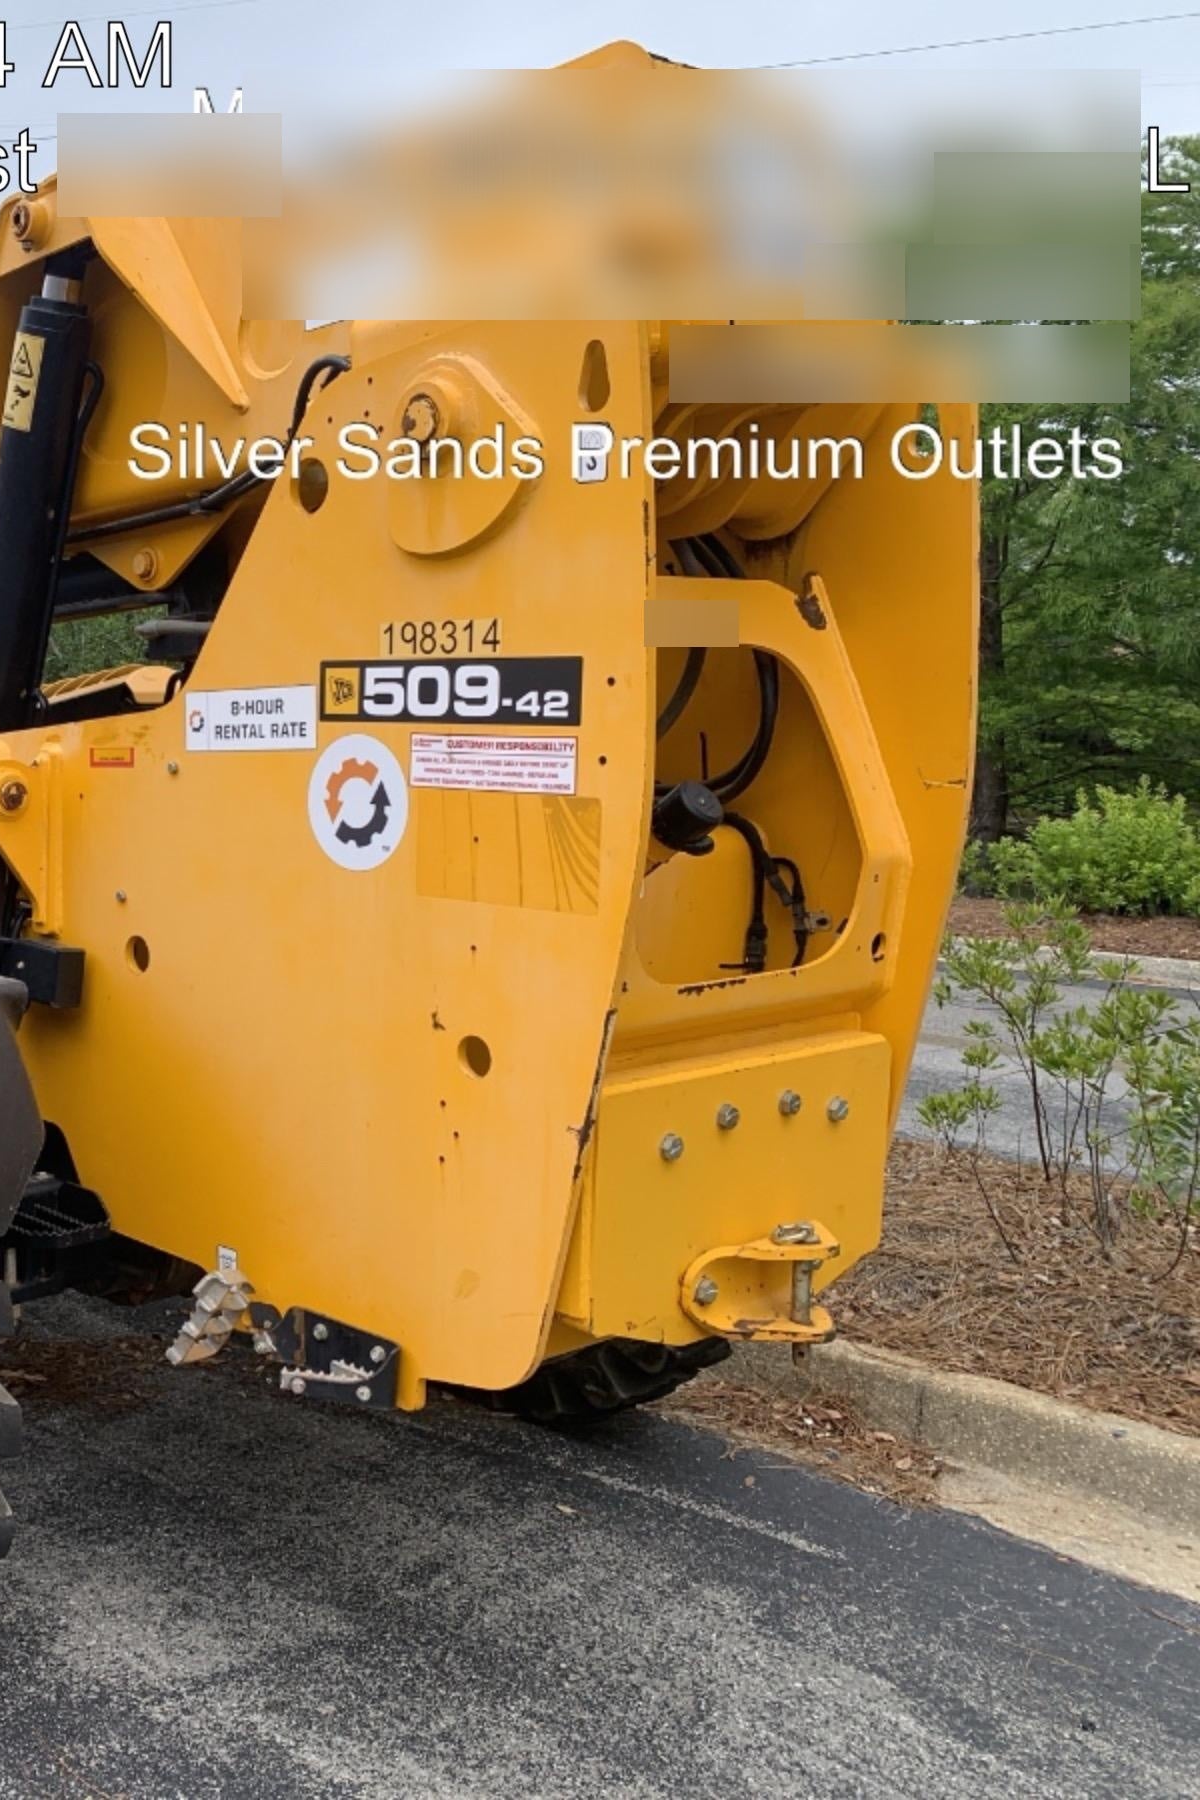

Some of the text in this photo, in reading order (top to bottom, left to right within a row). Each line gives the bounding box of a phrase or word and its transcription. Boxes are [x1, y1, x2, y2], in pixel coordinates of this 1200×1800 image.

[383, 618, 500, 655] 198314
[362, 664, 569, 717] 509-42
[230, 699, 285, 716] 8-HOUR
[214, 721, 307, 740] RENTAL RATE
